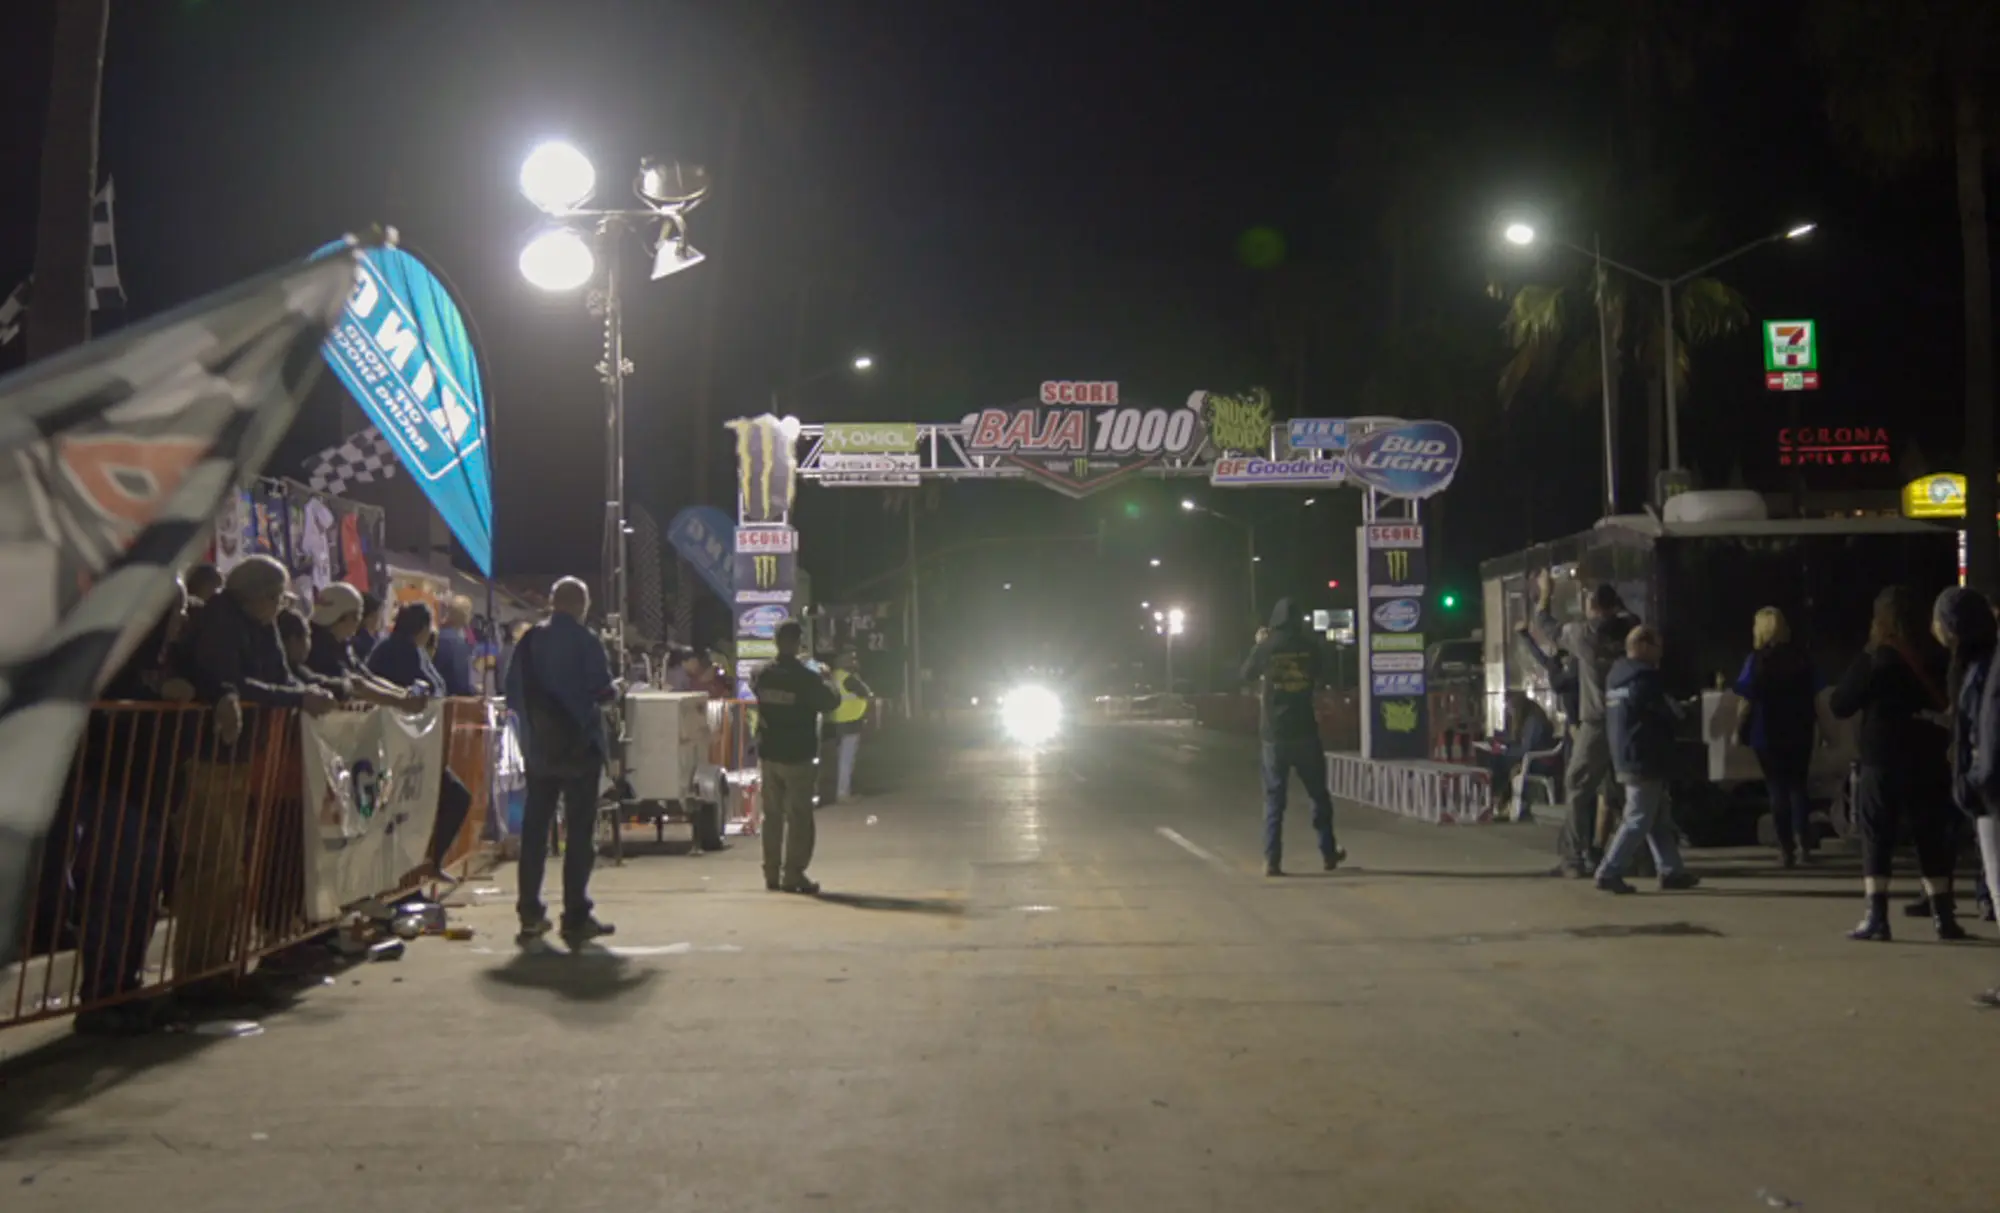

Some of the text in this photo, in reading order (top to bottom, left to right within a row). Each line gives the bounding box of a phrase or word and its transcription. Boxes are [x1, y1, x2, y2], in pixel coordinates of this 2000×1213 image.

[1776, 326, 1805, 366] 7
[1041, 381, 1118, 404] SCORE
[971, 407, 1196, 452] BAJA 1000
[1778, 427, 1890, 444] CORONA
[1379, 435, 1447, 456] BUD
[1216, 458, 1346, 476] BFGoodrich
[1364, 451, 1454, 473] LIGHT
[738, 531, 789, 546] SCORE
[1371, 527, 1421, 542] SCORE
